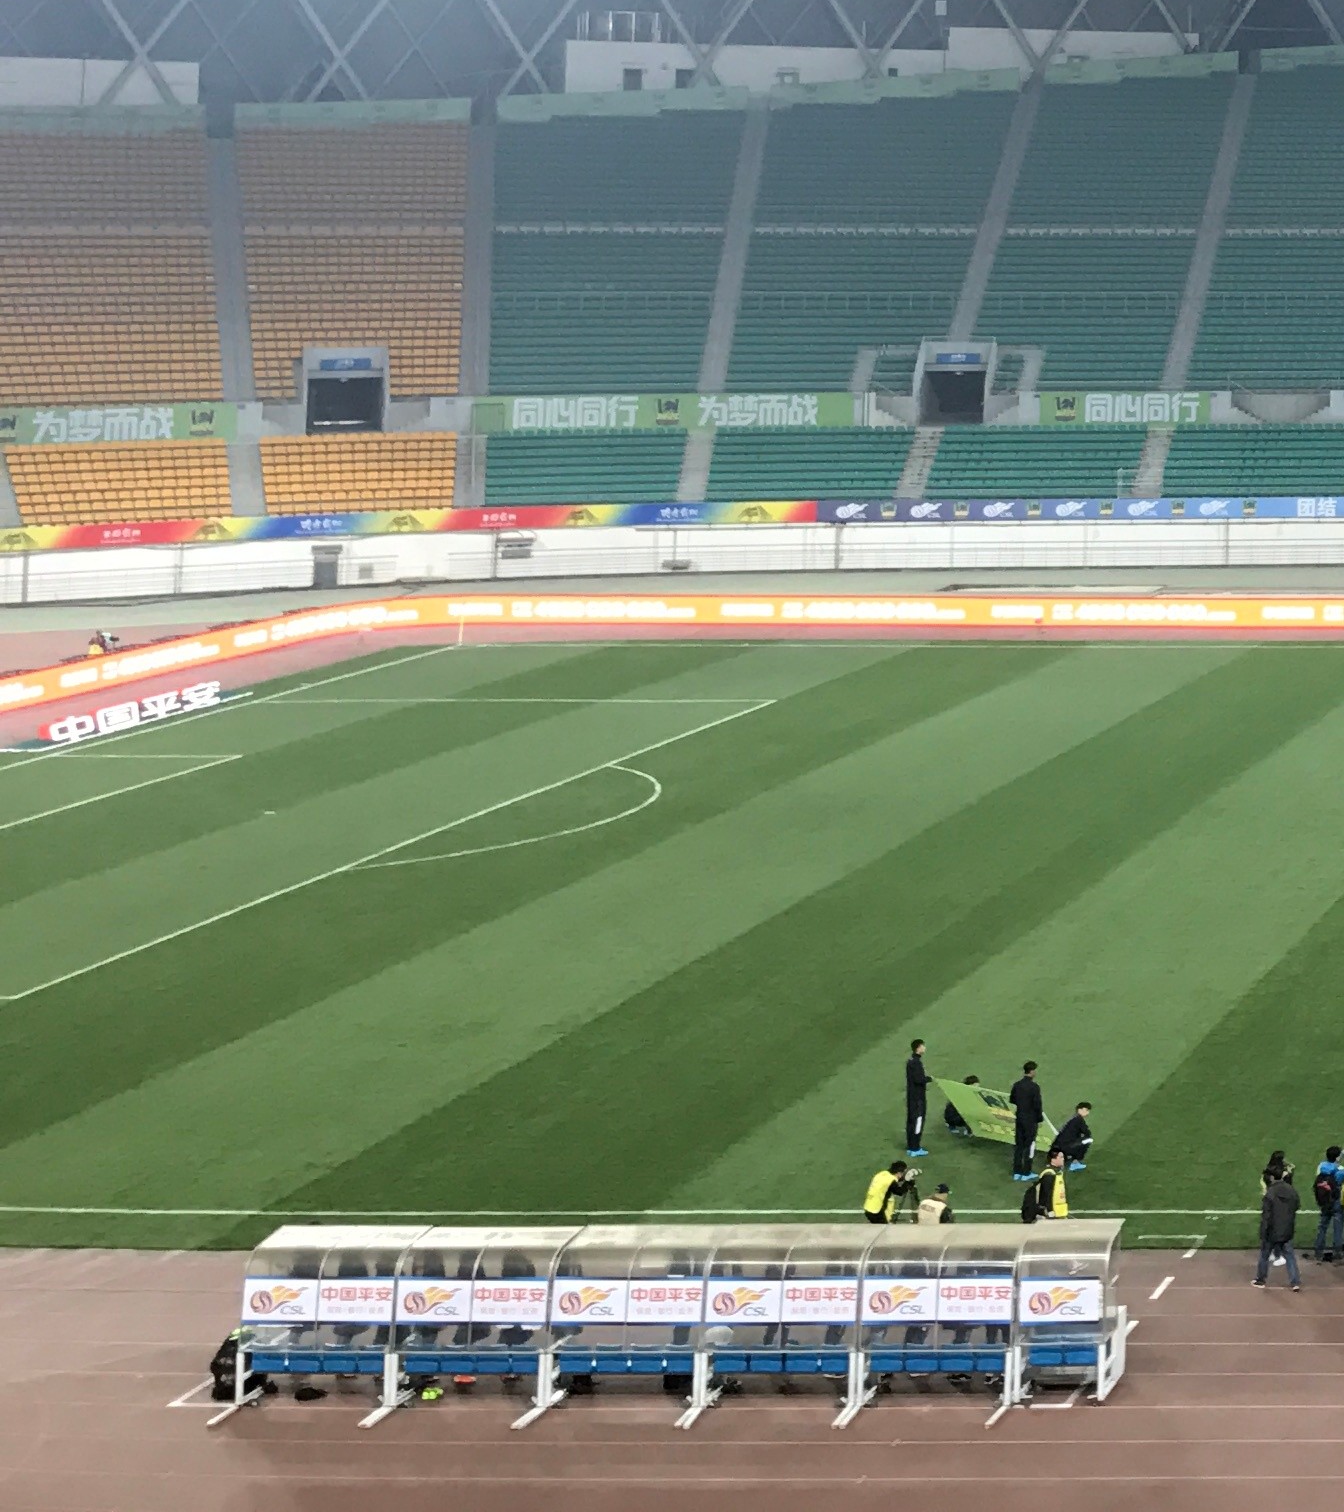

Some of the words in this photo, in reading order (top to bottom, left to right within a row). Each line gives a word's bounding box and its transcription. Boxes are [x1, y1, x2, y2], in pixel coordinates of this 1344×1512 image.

[512, 396, 639, 429] 同心同行
[698, 394, 818, 427] 为梦而战
[1084, 392, 1200, 424] 同心同行
[33, 406, 174, 443] 为梦而战
[1296, 496, 1337, 518] 团结
[49, 680, 221, 742] 中国平安
[321, 1286, 393, 1302] 中国平安
[474, 1286, 546, 1302] 中国平安
[630, 1287, 701, 1302] 中国平安
[785, 1286, 857, 1302] 中国平安
[940, 1285, 1011, 1301] 中国平安
[279, 1305, 306, 1315] CSL
[434, 1306, 460, 1316] CSL
[588, 1305, 615, 1316] CSL
[743, 1306, 769, 1317] CSL
[898, 1304, 926, 1315] CSL
[1058, 1305, 1086, 1316] CSL
